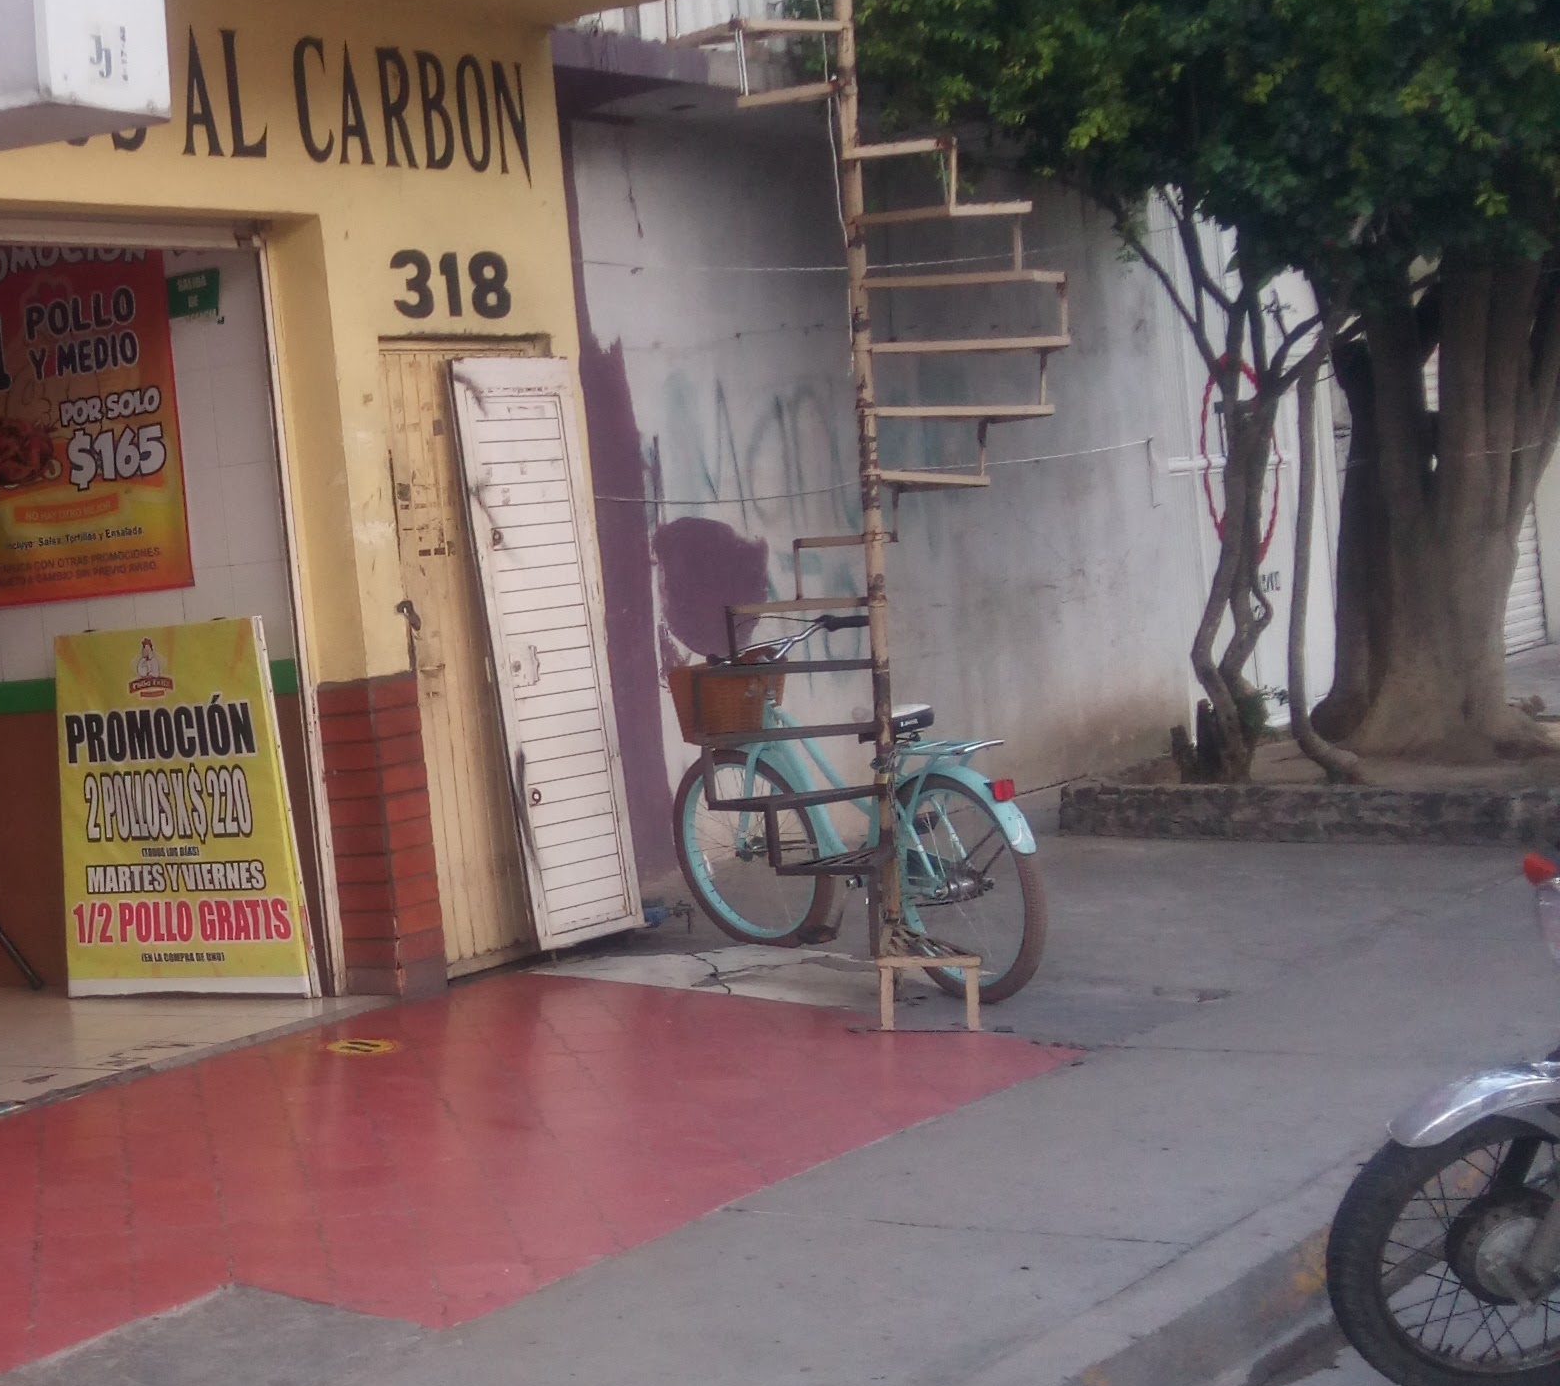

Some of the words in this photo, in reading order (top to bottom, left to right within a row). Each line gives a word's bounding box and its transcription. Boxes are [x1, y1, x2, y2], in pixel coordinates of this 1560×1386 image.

[182, 24, 268, 158] AL
[292, 34, 532, 189] CARBON
[25, 286, 135, 341] POLLO
[389, 249, 512, 319] 318
[28, 346, 48, 381] Y
[56, 330, 138, 378] MEDIO
[60, 396, 102, 427] POR
[104, 385, 162, 420] SOLO
[66, 422, 167, 491] $165
[64, 693, 257, 764] PROMOCIÓN
[83, 772, 101, 841] 2
[101, 770, 176, 842] POLLOS
[86, 863, 167, 894] MARTES
[165, 862, 181, 892] Y
[181, 860, 266, 892] VIERNES
[73, 902, 113, 944] 1/2
[119, 900, 193, 943] POLLO
[199, 898, 292, 941] GRATIS
